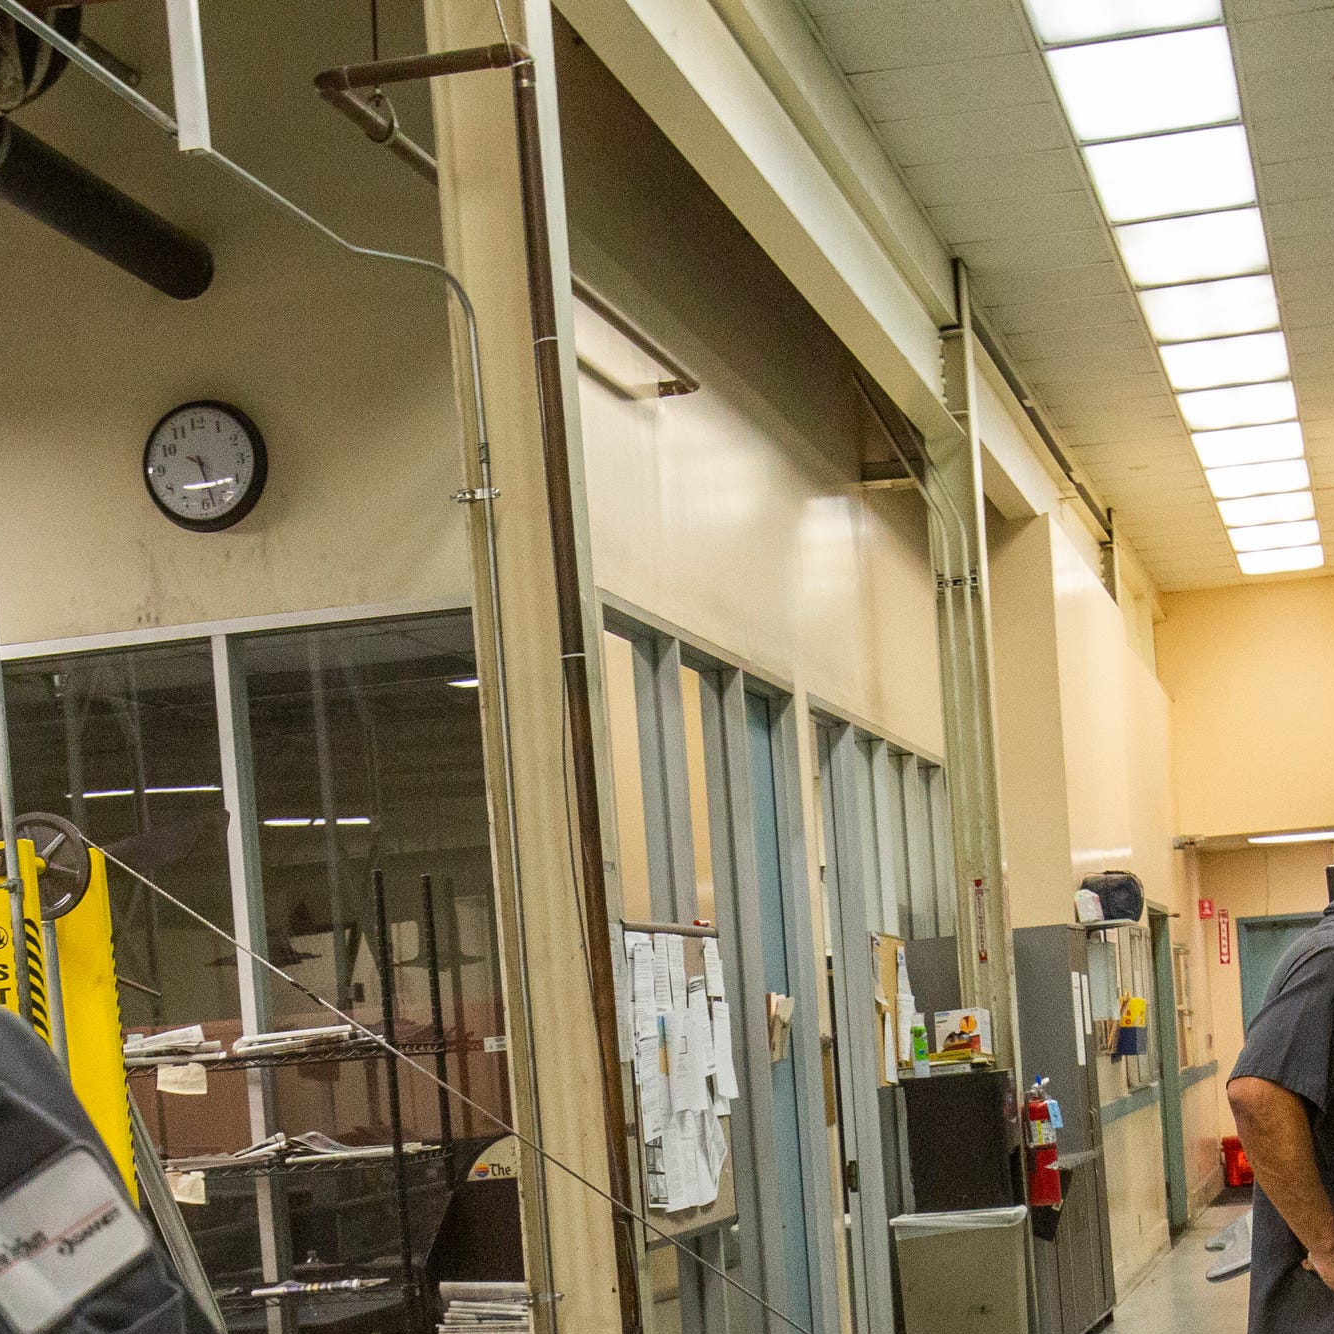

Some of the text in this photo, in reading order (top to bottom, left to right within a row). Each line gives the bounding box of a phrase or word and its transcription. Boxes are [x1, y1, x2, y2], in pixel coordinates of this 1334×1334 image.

[190, 417, 205, 431] 12
[173, 426, 186, 440] 11
[162, 444, 177, 457] 10
[489, 1163, 511, 1177] The
